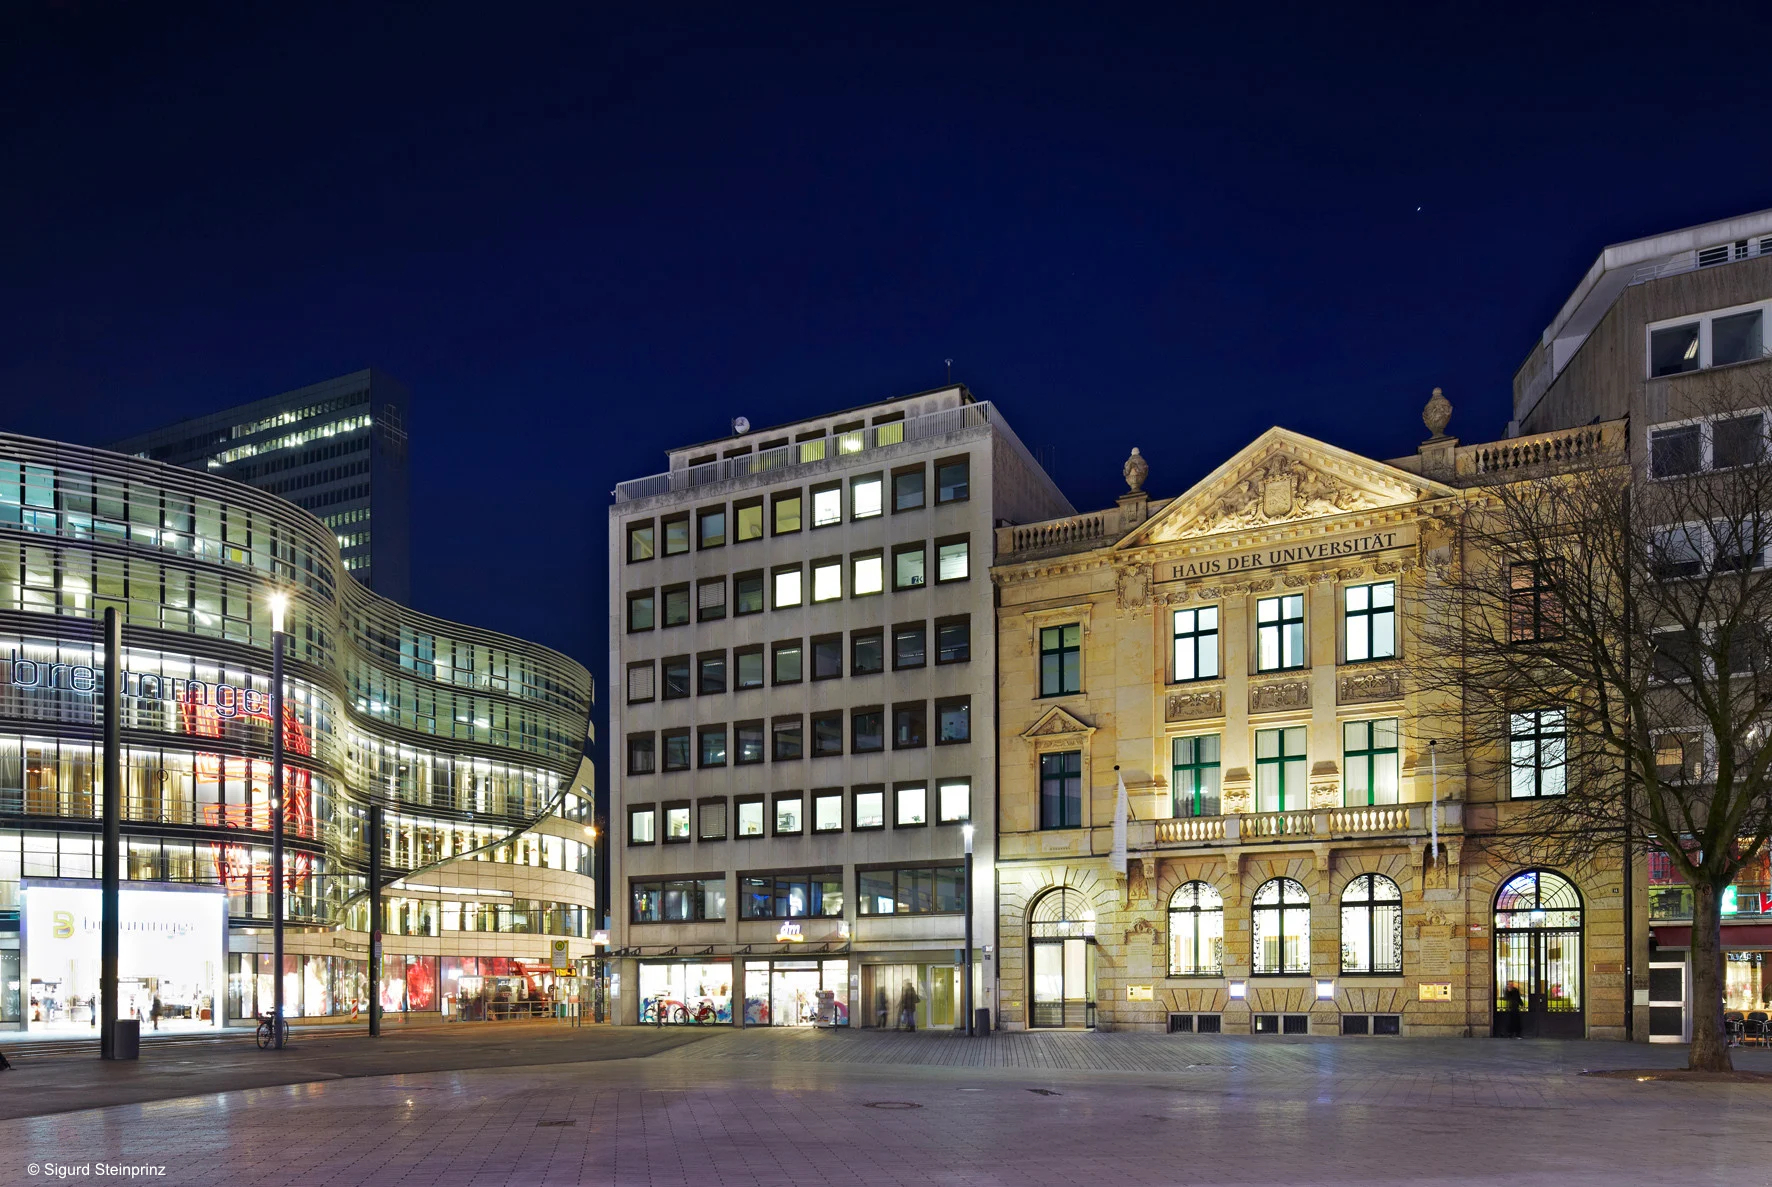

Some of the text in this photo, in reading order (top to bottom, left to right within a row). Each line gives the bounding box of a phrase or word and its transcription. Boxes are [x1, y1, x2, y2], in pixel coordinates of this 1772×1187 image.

[1172, 533, 1397, 578] HAUS DER UNIVERSITÄT
